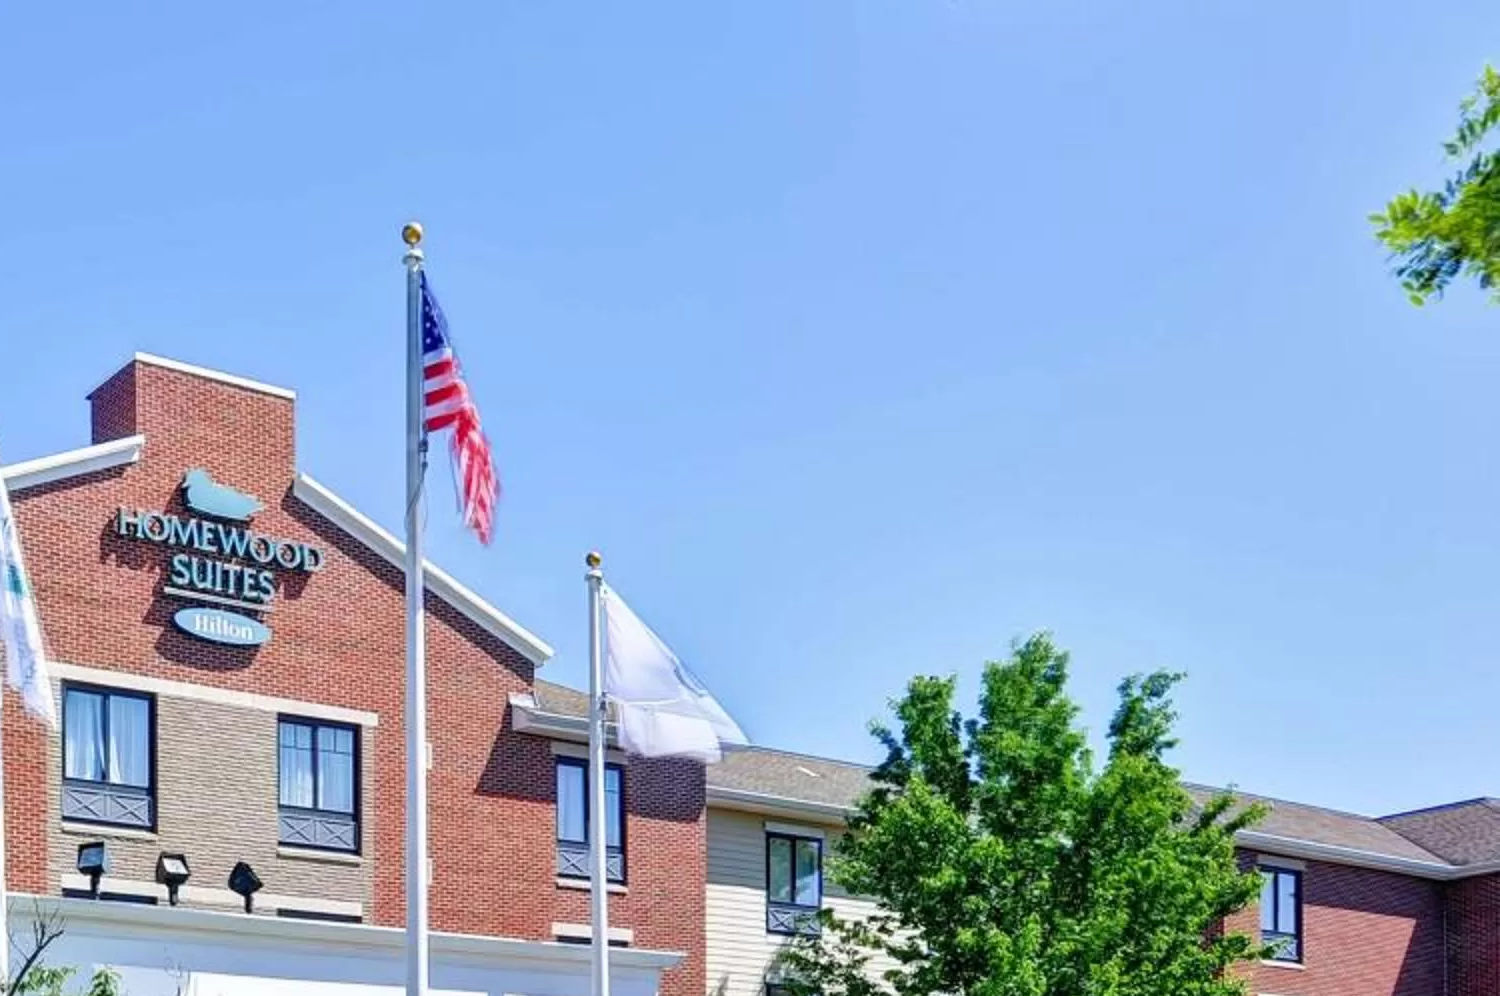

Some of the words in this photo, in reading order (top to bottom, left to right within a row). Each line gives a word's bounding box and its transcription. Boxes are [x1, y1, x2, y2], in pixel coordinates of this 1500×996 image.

[118, 508, 325, 572] HOMEWOOD
[170, 553, 275, 602] SUITES
[194, 614, 254, 641] Hilton
